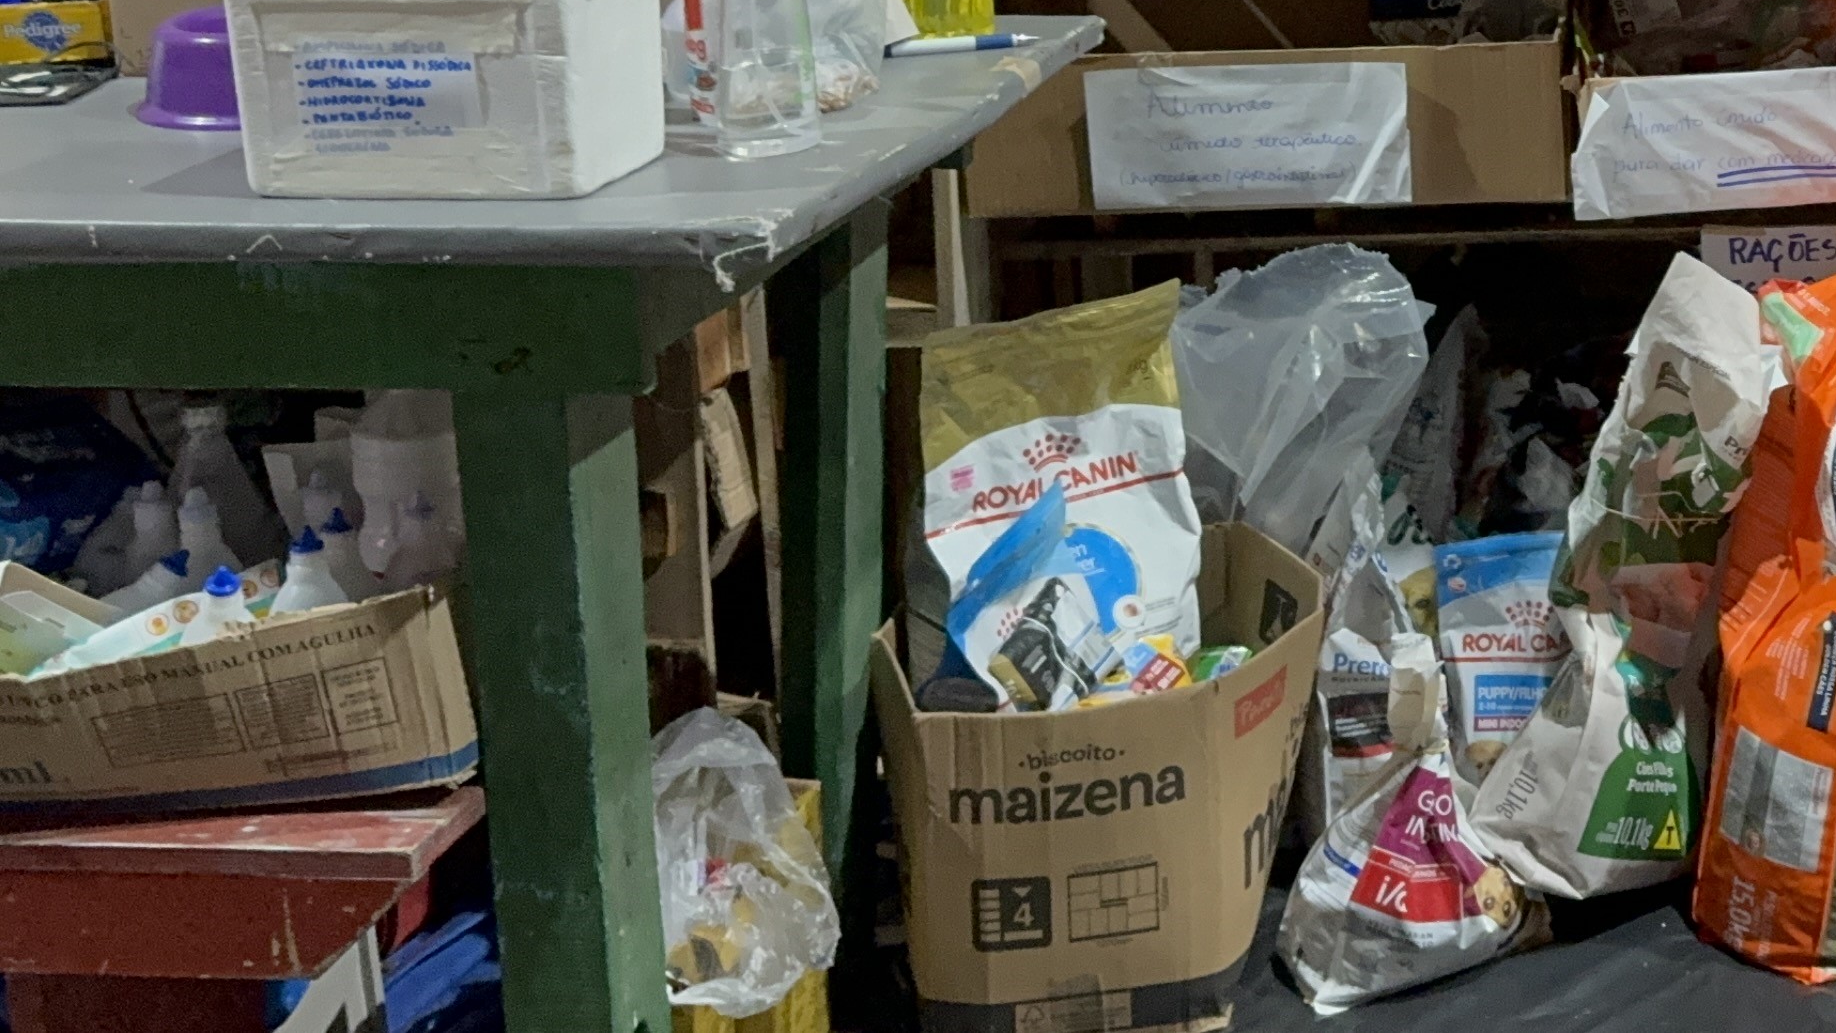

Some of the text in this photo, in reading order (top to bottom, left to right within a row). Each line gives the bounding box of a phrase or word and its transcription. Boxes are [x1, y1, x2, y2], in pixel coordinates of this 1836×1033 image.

[3, 20, 82, 40] Pedigree
[1055, 450, 1138, 492] CANIN
[247, 641, 299, 665] COM
[300, 623, 376, 653] AGULHA
[1462, 632, 1526, 653] ROYAL
[1026, 744, 1117, 771] biscoito
[948, 764, 1187, 825] maizena
[1665, 825, 1676, 844] T
[1013, 902, 1036, 927] 4
